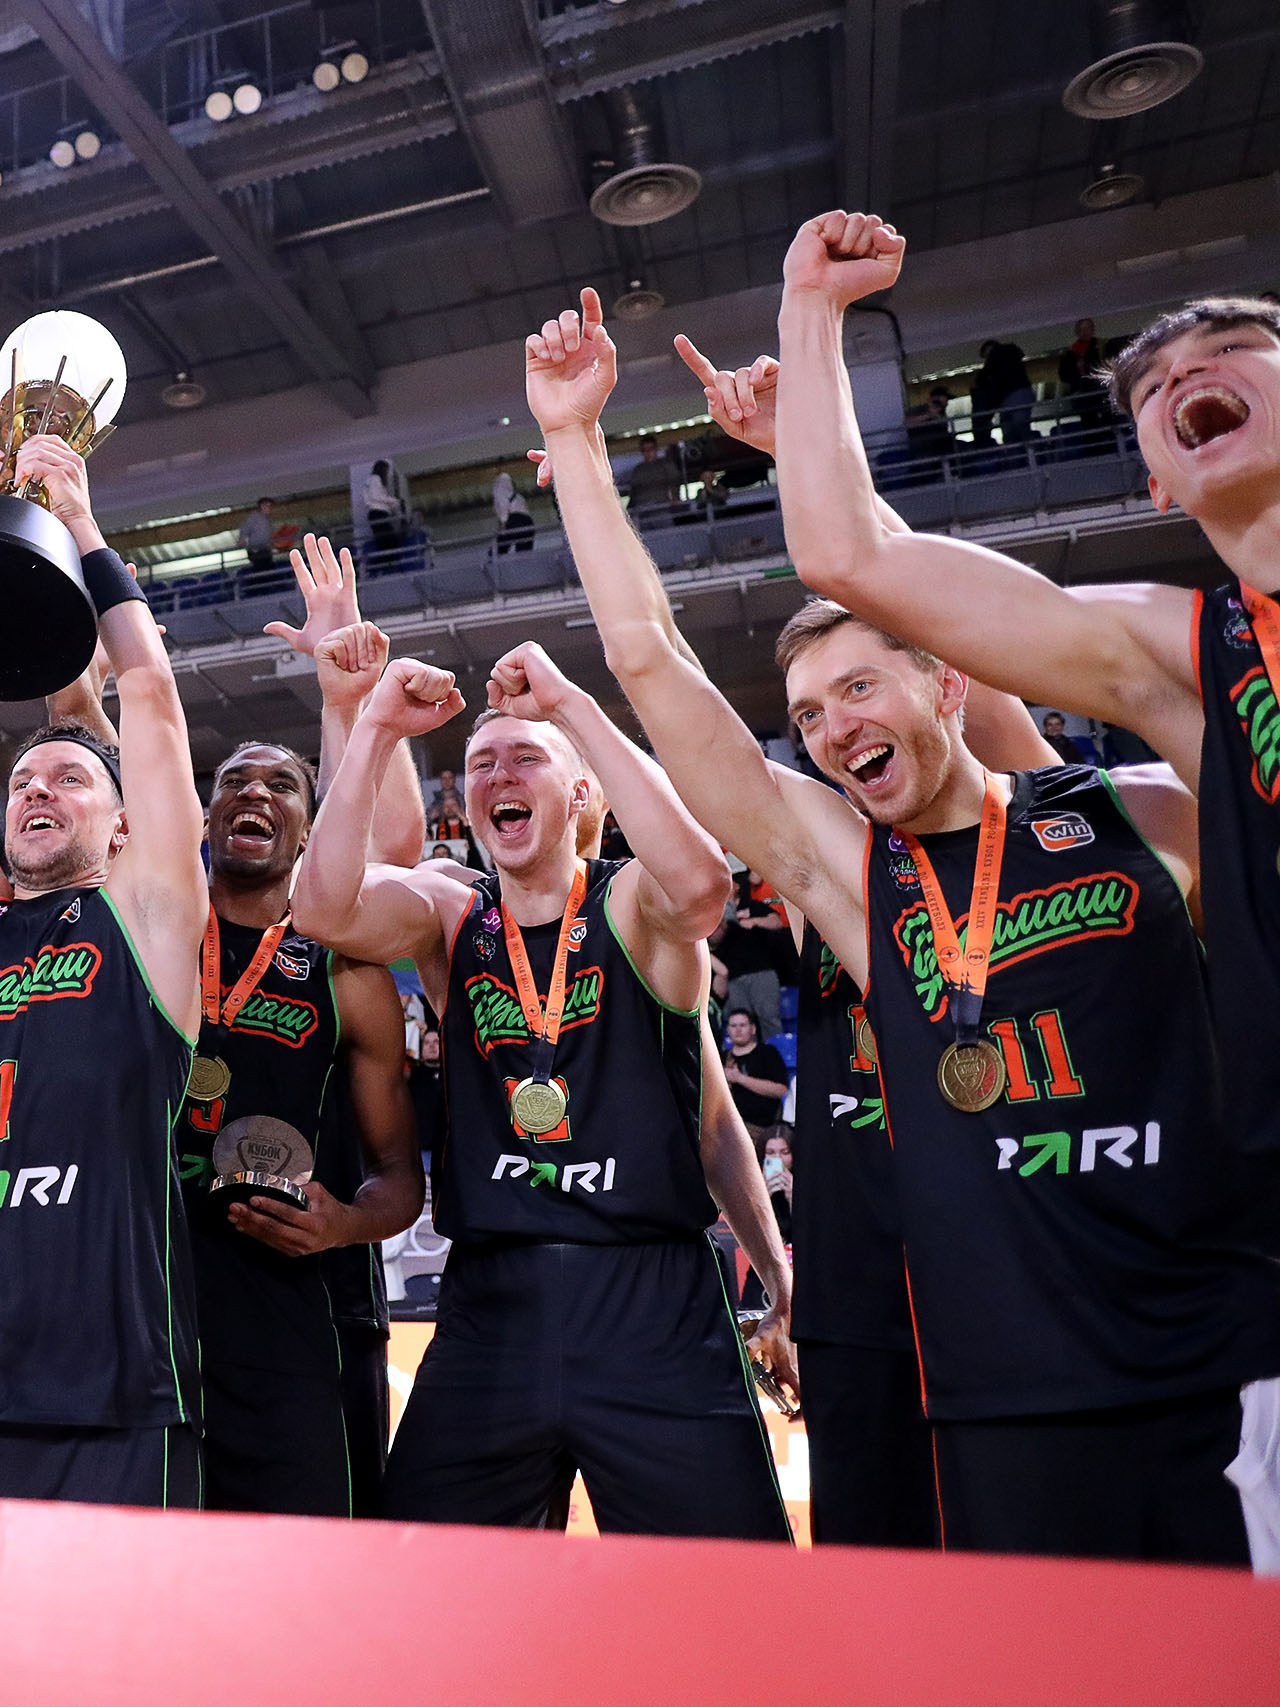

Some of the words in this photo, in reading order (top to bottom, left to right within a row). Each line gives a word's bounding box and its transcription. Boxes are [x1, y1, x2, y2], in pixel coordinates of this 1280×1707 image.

[983, 844, 995, 869] КУБОК
[923, 884, 947, 931] БАСКЕТБОЛУ
[978, 872, 992, 908] WINLINE
[975, 909, 986, 930] XXIV
[987, 1008, 1085, 1104] 11
[247, 1142, 281, 1160] КУБОК
[996, 1121, 1161, 1177] PARI
[491, 1153, 616, 1194] PARI
